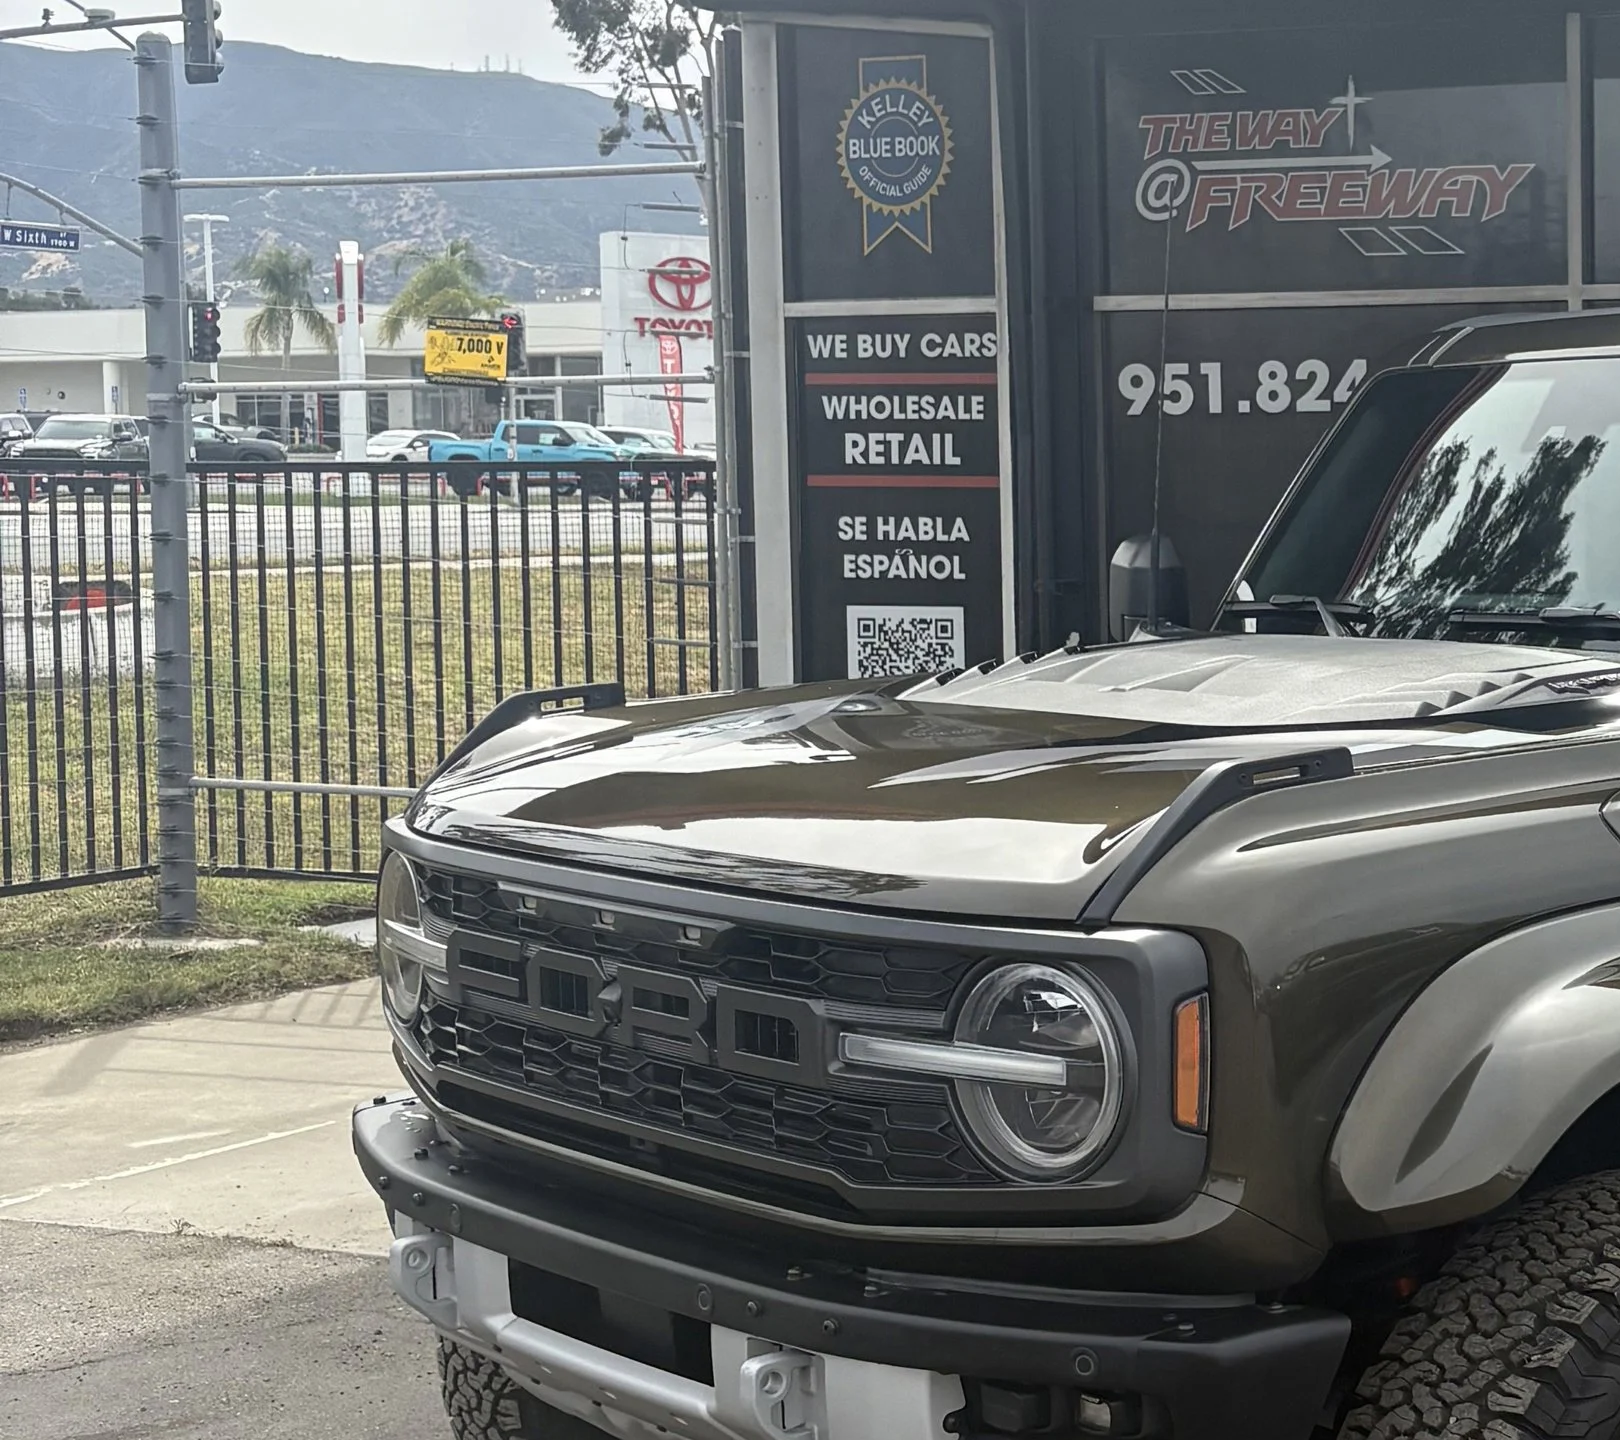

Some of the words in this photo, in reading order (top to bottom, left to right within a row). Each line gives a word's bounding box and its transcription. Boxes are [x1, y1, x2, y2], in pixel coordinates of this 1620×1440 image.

[857, 94, 934, 129] KELLEY
[849, 137, 892, 159] BLUE
[894, 135, 940, 157] BOOK
[1138, 111, 1233, 160] THE
[1236, 107, 1347, 150] WAY
[858, 165, 903, 197] OFFICIAL
[903, 164, 932, 194] GUIDE
[1134, 157, 1537, 233] @FREEWAY
[3, 228, 12, 241] W
[16, 229, 47, 244] Sixth
[634, 317, 713, 340] TOYOT
[456, 337, 492, 354] 7,000
[496, 341, 504, 355] V
[807, 334, 847, 358] WE
[857, 333, 911, 358] BUY
[919, 332, 998, 358] CARS
[821, 395, 985, 420] WHOLESALE
[844, 432, 961, 466] RETAIL
[838, 516, 867, 541] SE
[876, 516, 970, 542] HABLA
[843, 548, 966, 580] ESPAÑOL
[446, 928, 826, 1088] FORD
